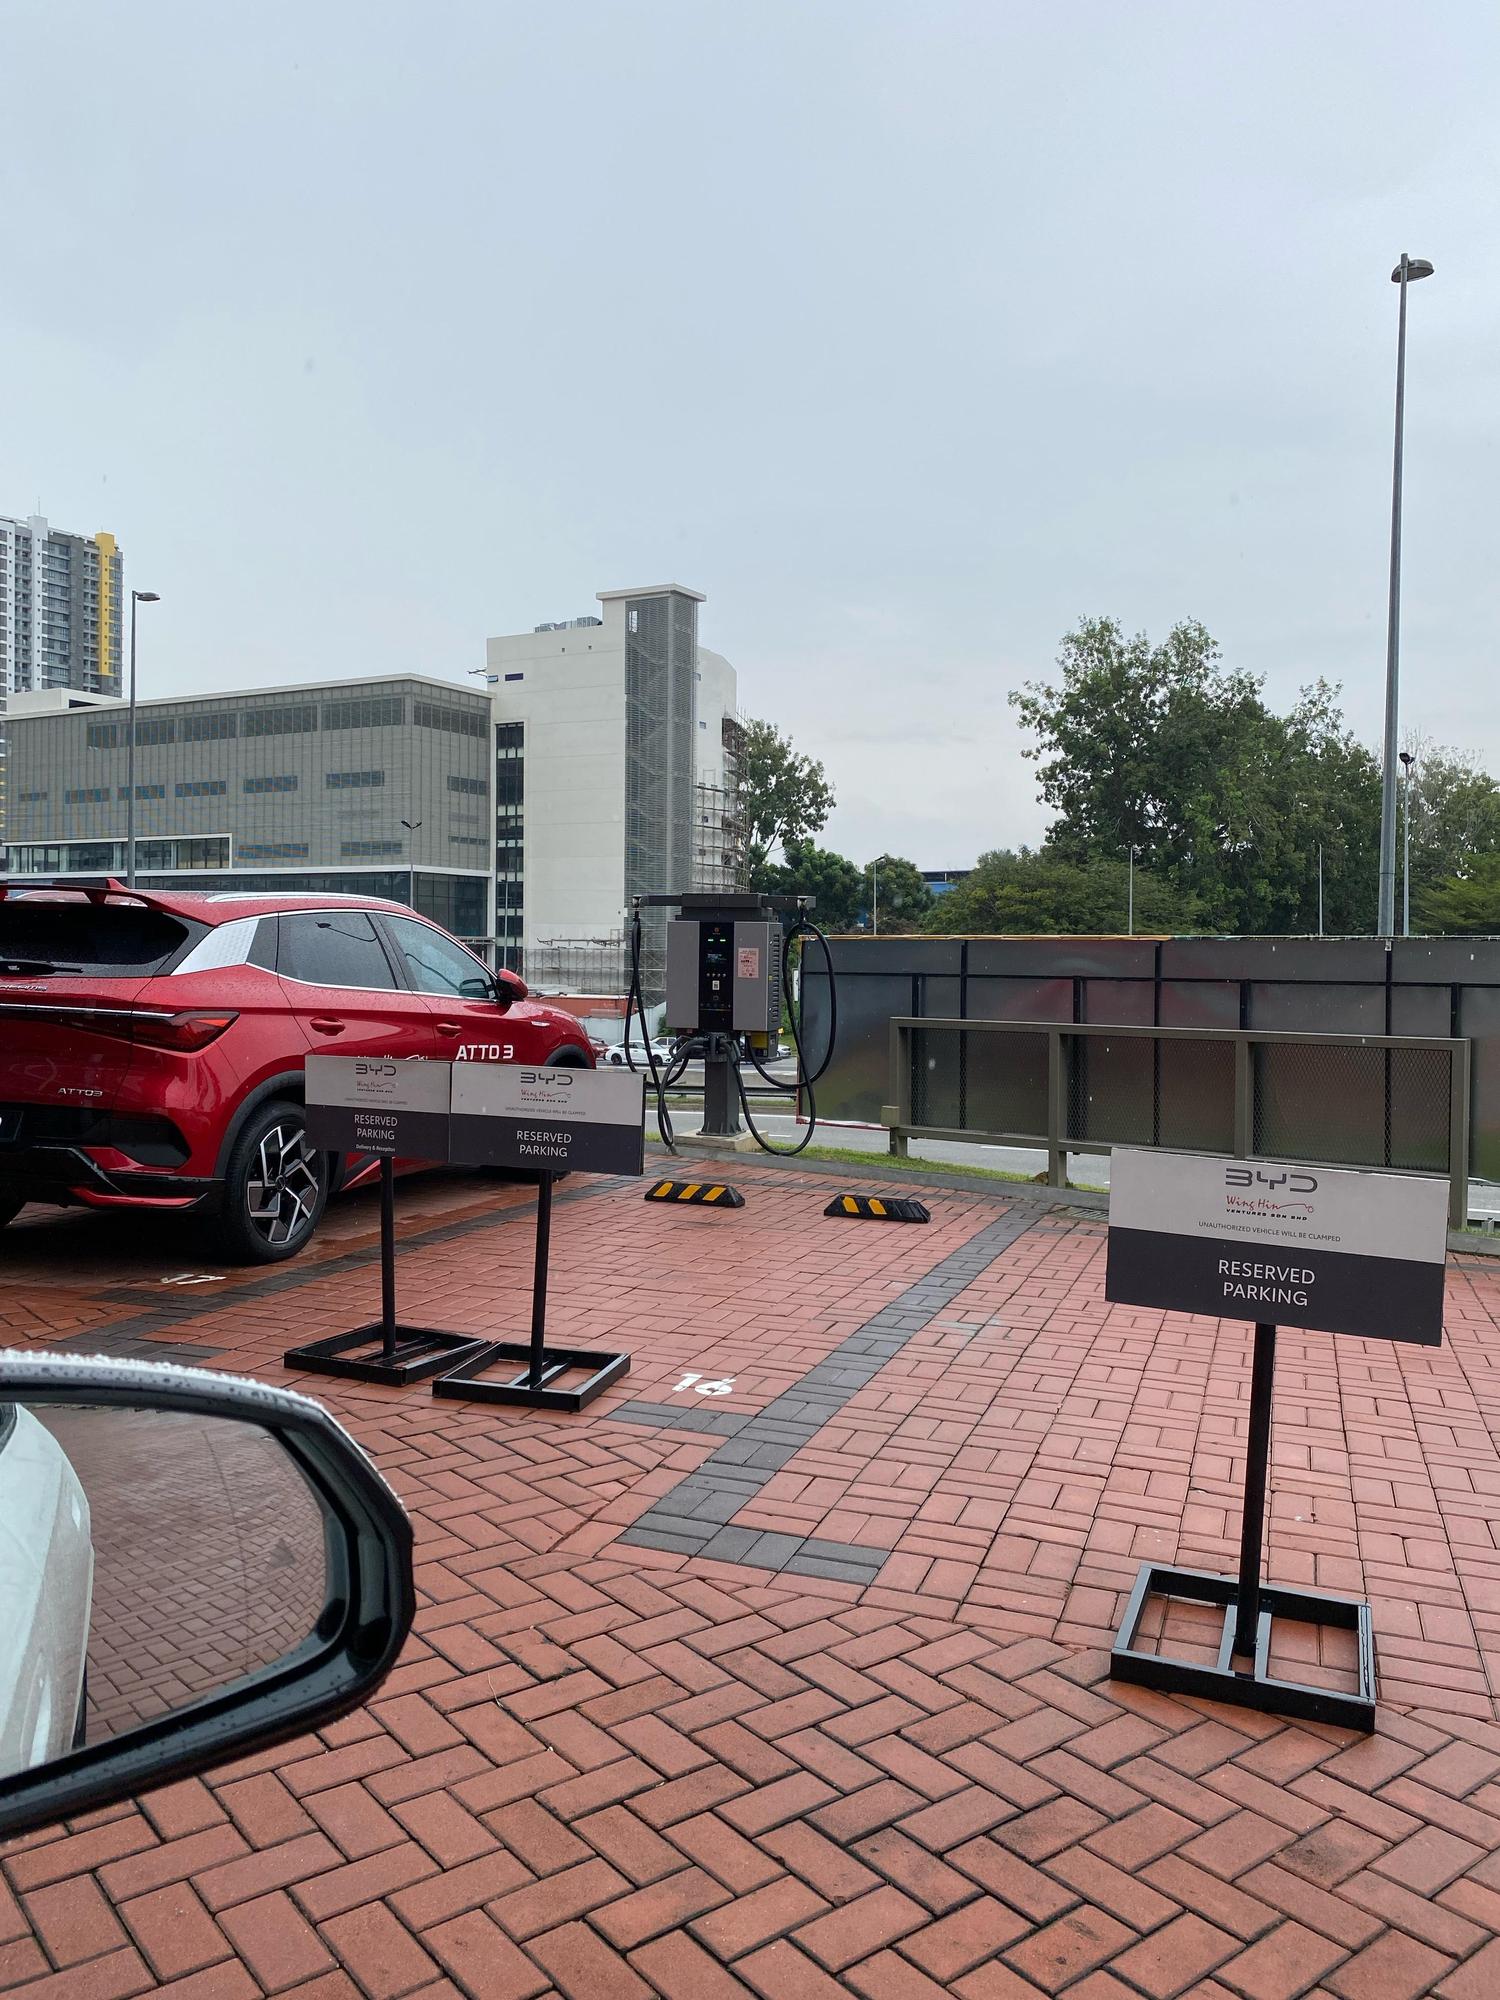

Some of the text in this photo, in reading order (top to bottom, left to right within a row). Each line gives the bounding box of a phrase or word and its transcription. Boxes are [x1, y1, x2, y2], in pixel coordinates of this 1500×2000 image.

[455, 1044, 514, 1060] ATTO 3
[355, 1063, 397, 1076] BYD
[520, 1071, 573, 1085] BYD
[354, 1114, 398, 1127] RESERVED
[356, 1127, 395, 1140] PARKING
[516, 1130, 572, 1144] RESERVED
[519, 1144, 568, 1158] PARKING
[1225, 1167, 1318, 1193] BYD
[1226, 1195, 1281, 1210] Wing Hin
[1226, 1208, 1267, 1217] VENTURES
[1198, 1221, 1341, 1242] UNAUTHORIZED VEHICLE WILL BE CLAMPED
[1218, 1259, 1315, 1284] RESERVED
[1223, 1281, 1308, 1306] PARKING
[671, 1372, 737, 1396] 16
